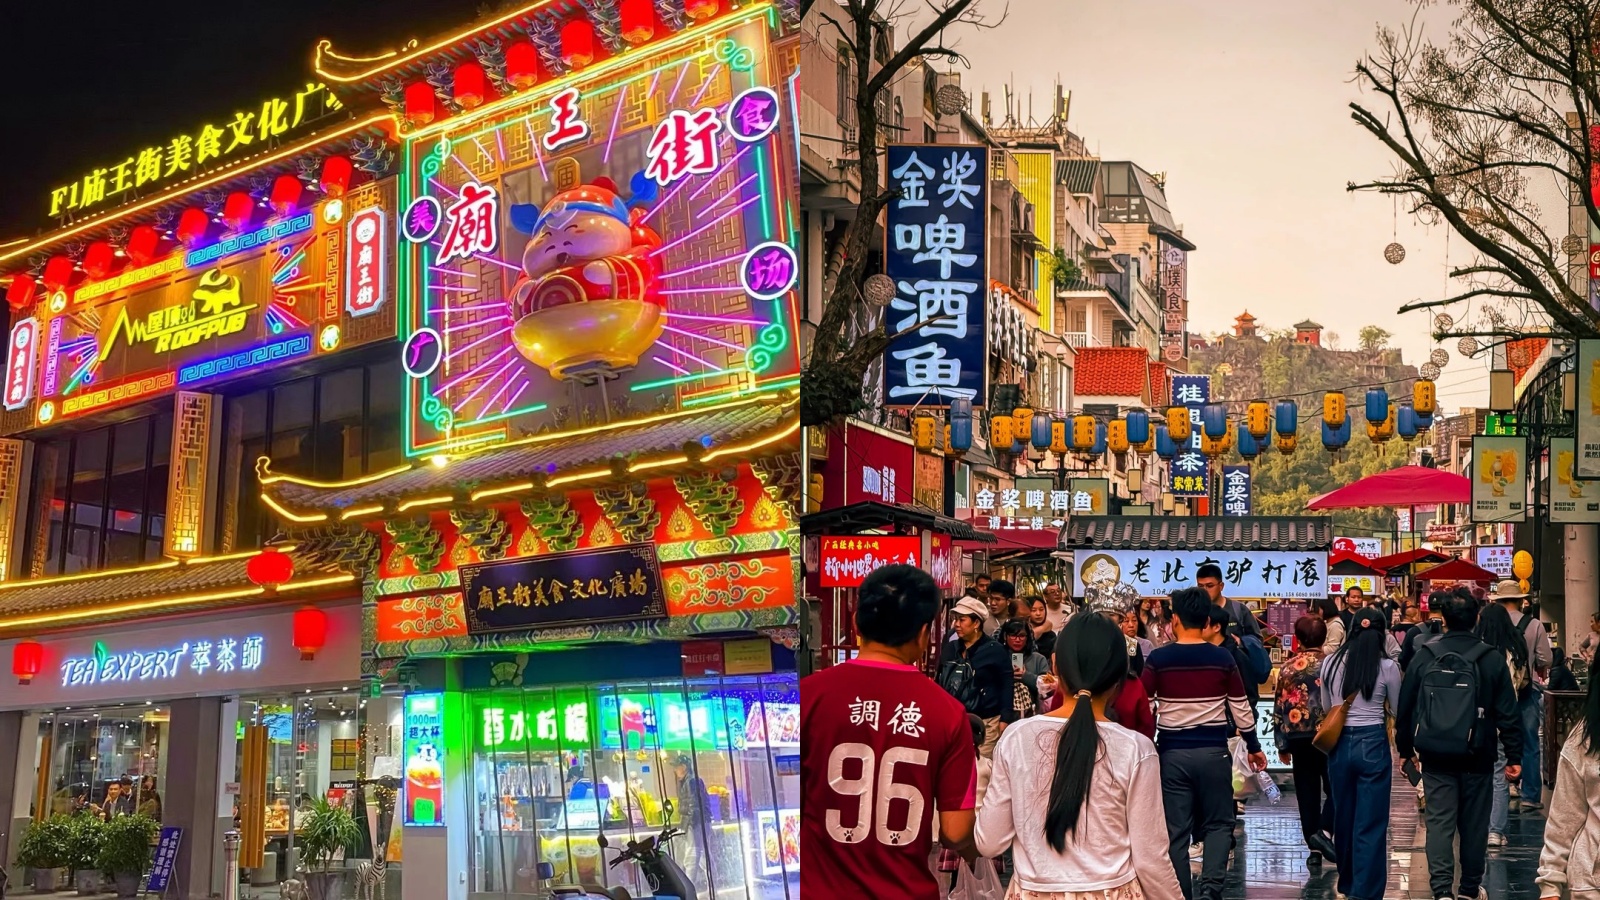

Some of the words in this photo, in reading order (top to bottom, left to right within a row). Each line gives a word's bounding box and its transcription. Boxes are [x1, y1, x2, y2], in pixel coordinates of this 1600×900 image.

[735, 95, 774, 135] 食
[408, 202, 435, 234] 美
[749, 252, 791, 291] 场
[409, 335, 435, 368] 广
[976, 488, 1093, 511] 金奖啤酒鱼
[1172, 476, 1205, 491] 家常菜
[987, 515, 1044, 530] 请上二楼
[1129, 556, 1321, 588] 老北驴打滚
[61, 657, 97, 687] TEA
[407, 713, 440, 725] 1000ml
[848, 695, 926, 738] 調德
[825, 742, 930, 847] 96
